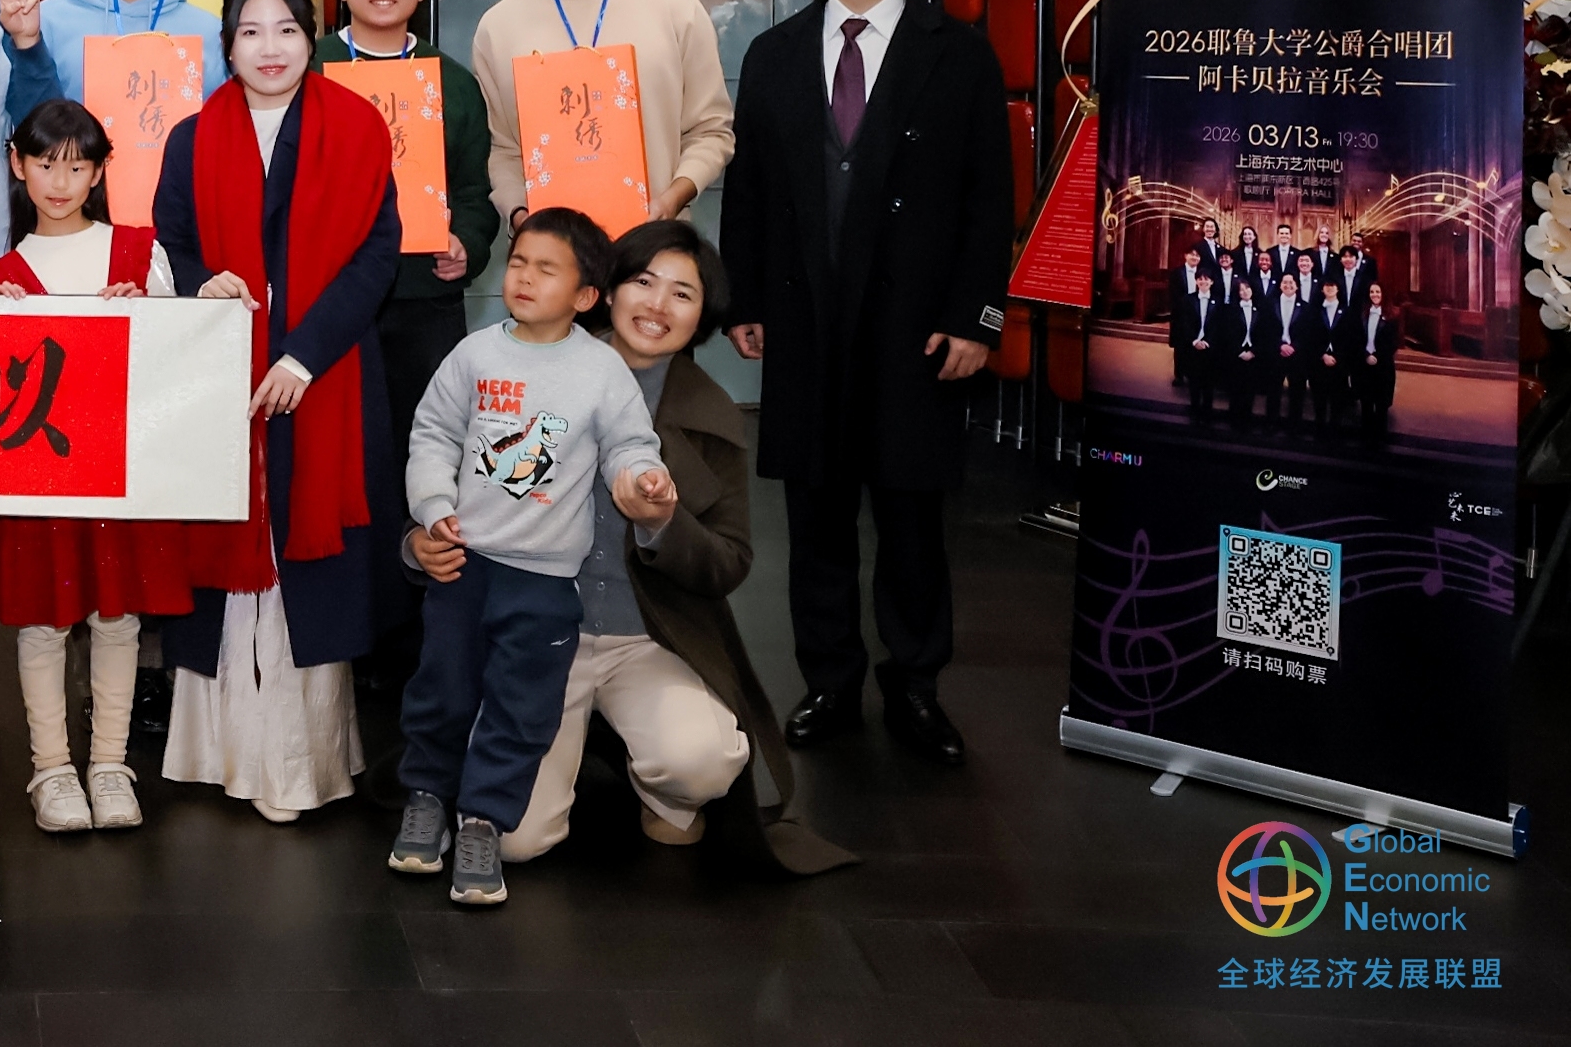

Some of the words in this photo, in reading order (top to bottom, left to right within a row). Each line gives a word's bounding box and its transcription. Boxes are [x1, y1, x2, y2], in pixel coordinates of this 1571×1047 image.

[1144, 28, 1454, 60] 2026耶鲁大学公爵合唱团
[1198, 65, 1384, 97] 阿卡贝拉音乐会
[1203, 126, 1241, 143] 2026
[1248, 124, 1319, 149] 03/13
[1338, 131, 1379, 149] 19:30
[1235, 153, 1344, 173] 上海东方艺术中心
[477, 379, 526, 398] HERE
[489, 396, 521, 415] AM
[1278, 474, 1308, 485] CHANCE
[1467, 504, 1491, 516] TCE
[1222, 647, 1327, 684] 请扫码购票
